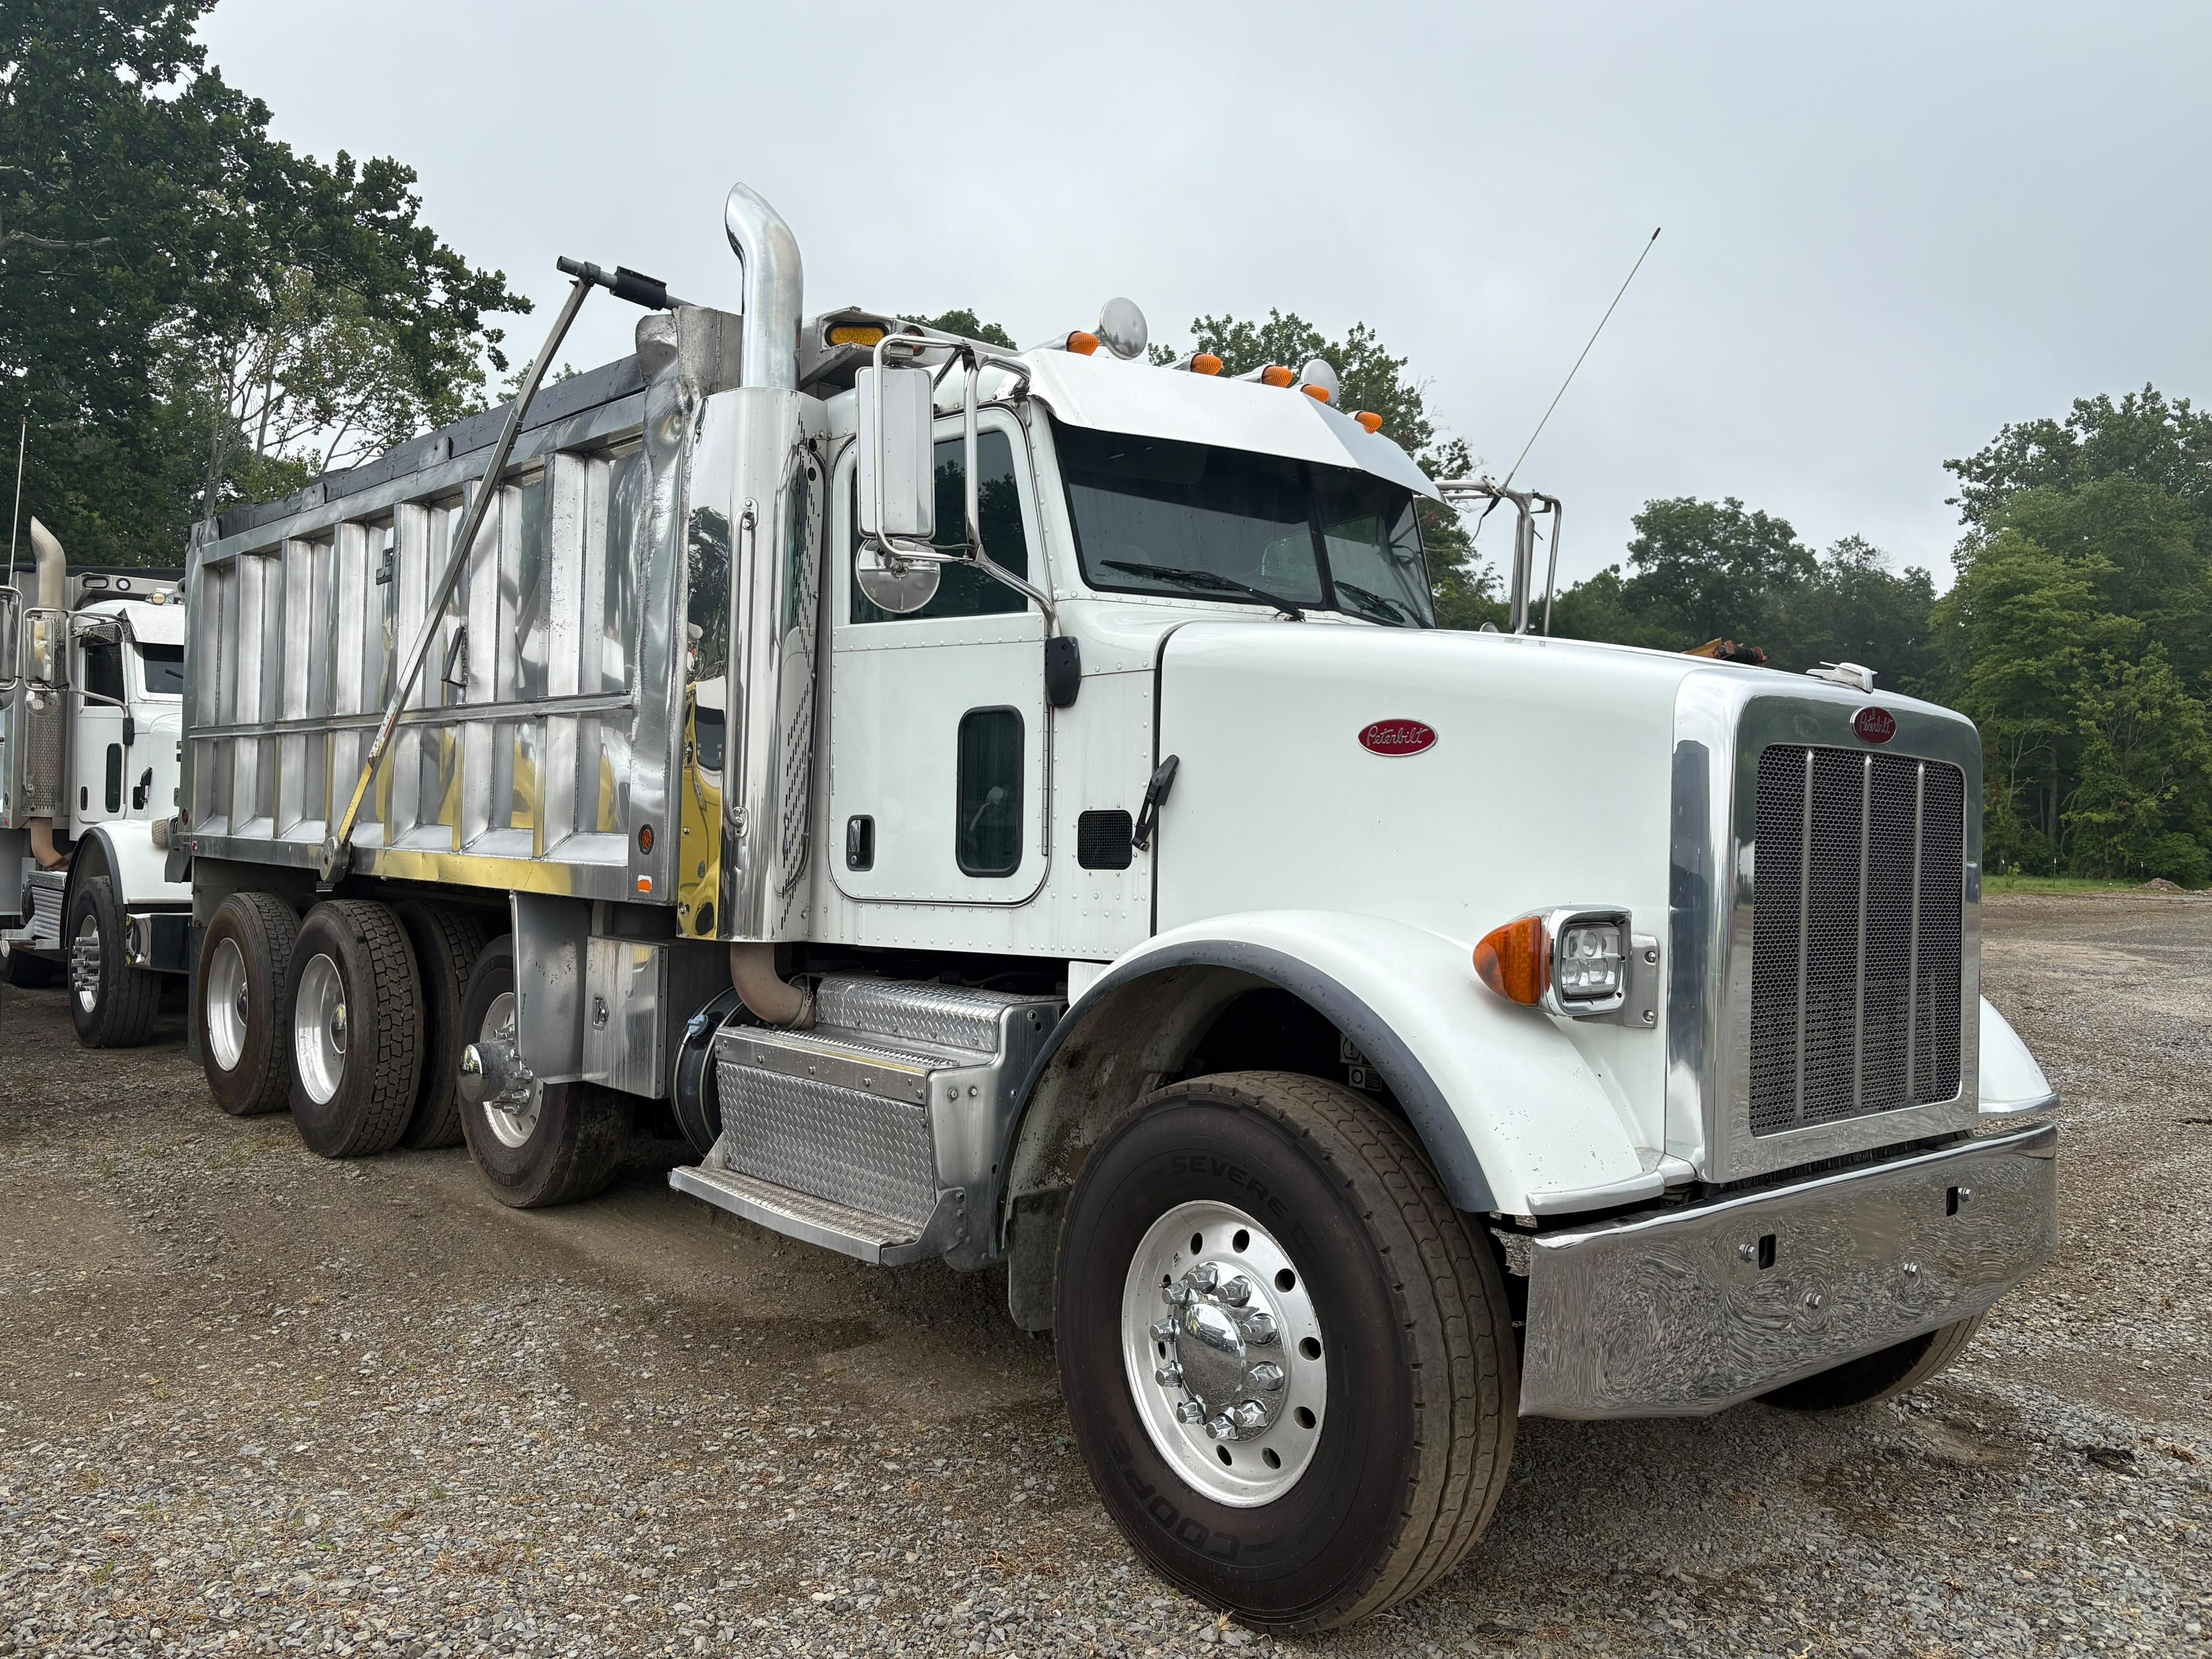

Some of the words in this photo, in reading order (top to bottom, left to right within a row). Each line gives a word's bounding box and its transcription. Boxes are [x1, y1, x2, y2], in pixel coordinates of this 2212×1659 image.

[1859, 711, 1893, 734] Peterbilt
[1366, 725, 1429, 747] Peterbilt
[1171, 1155, 1290, 1221] SEVERE
